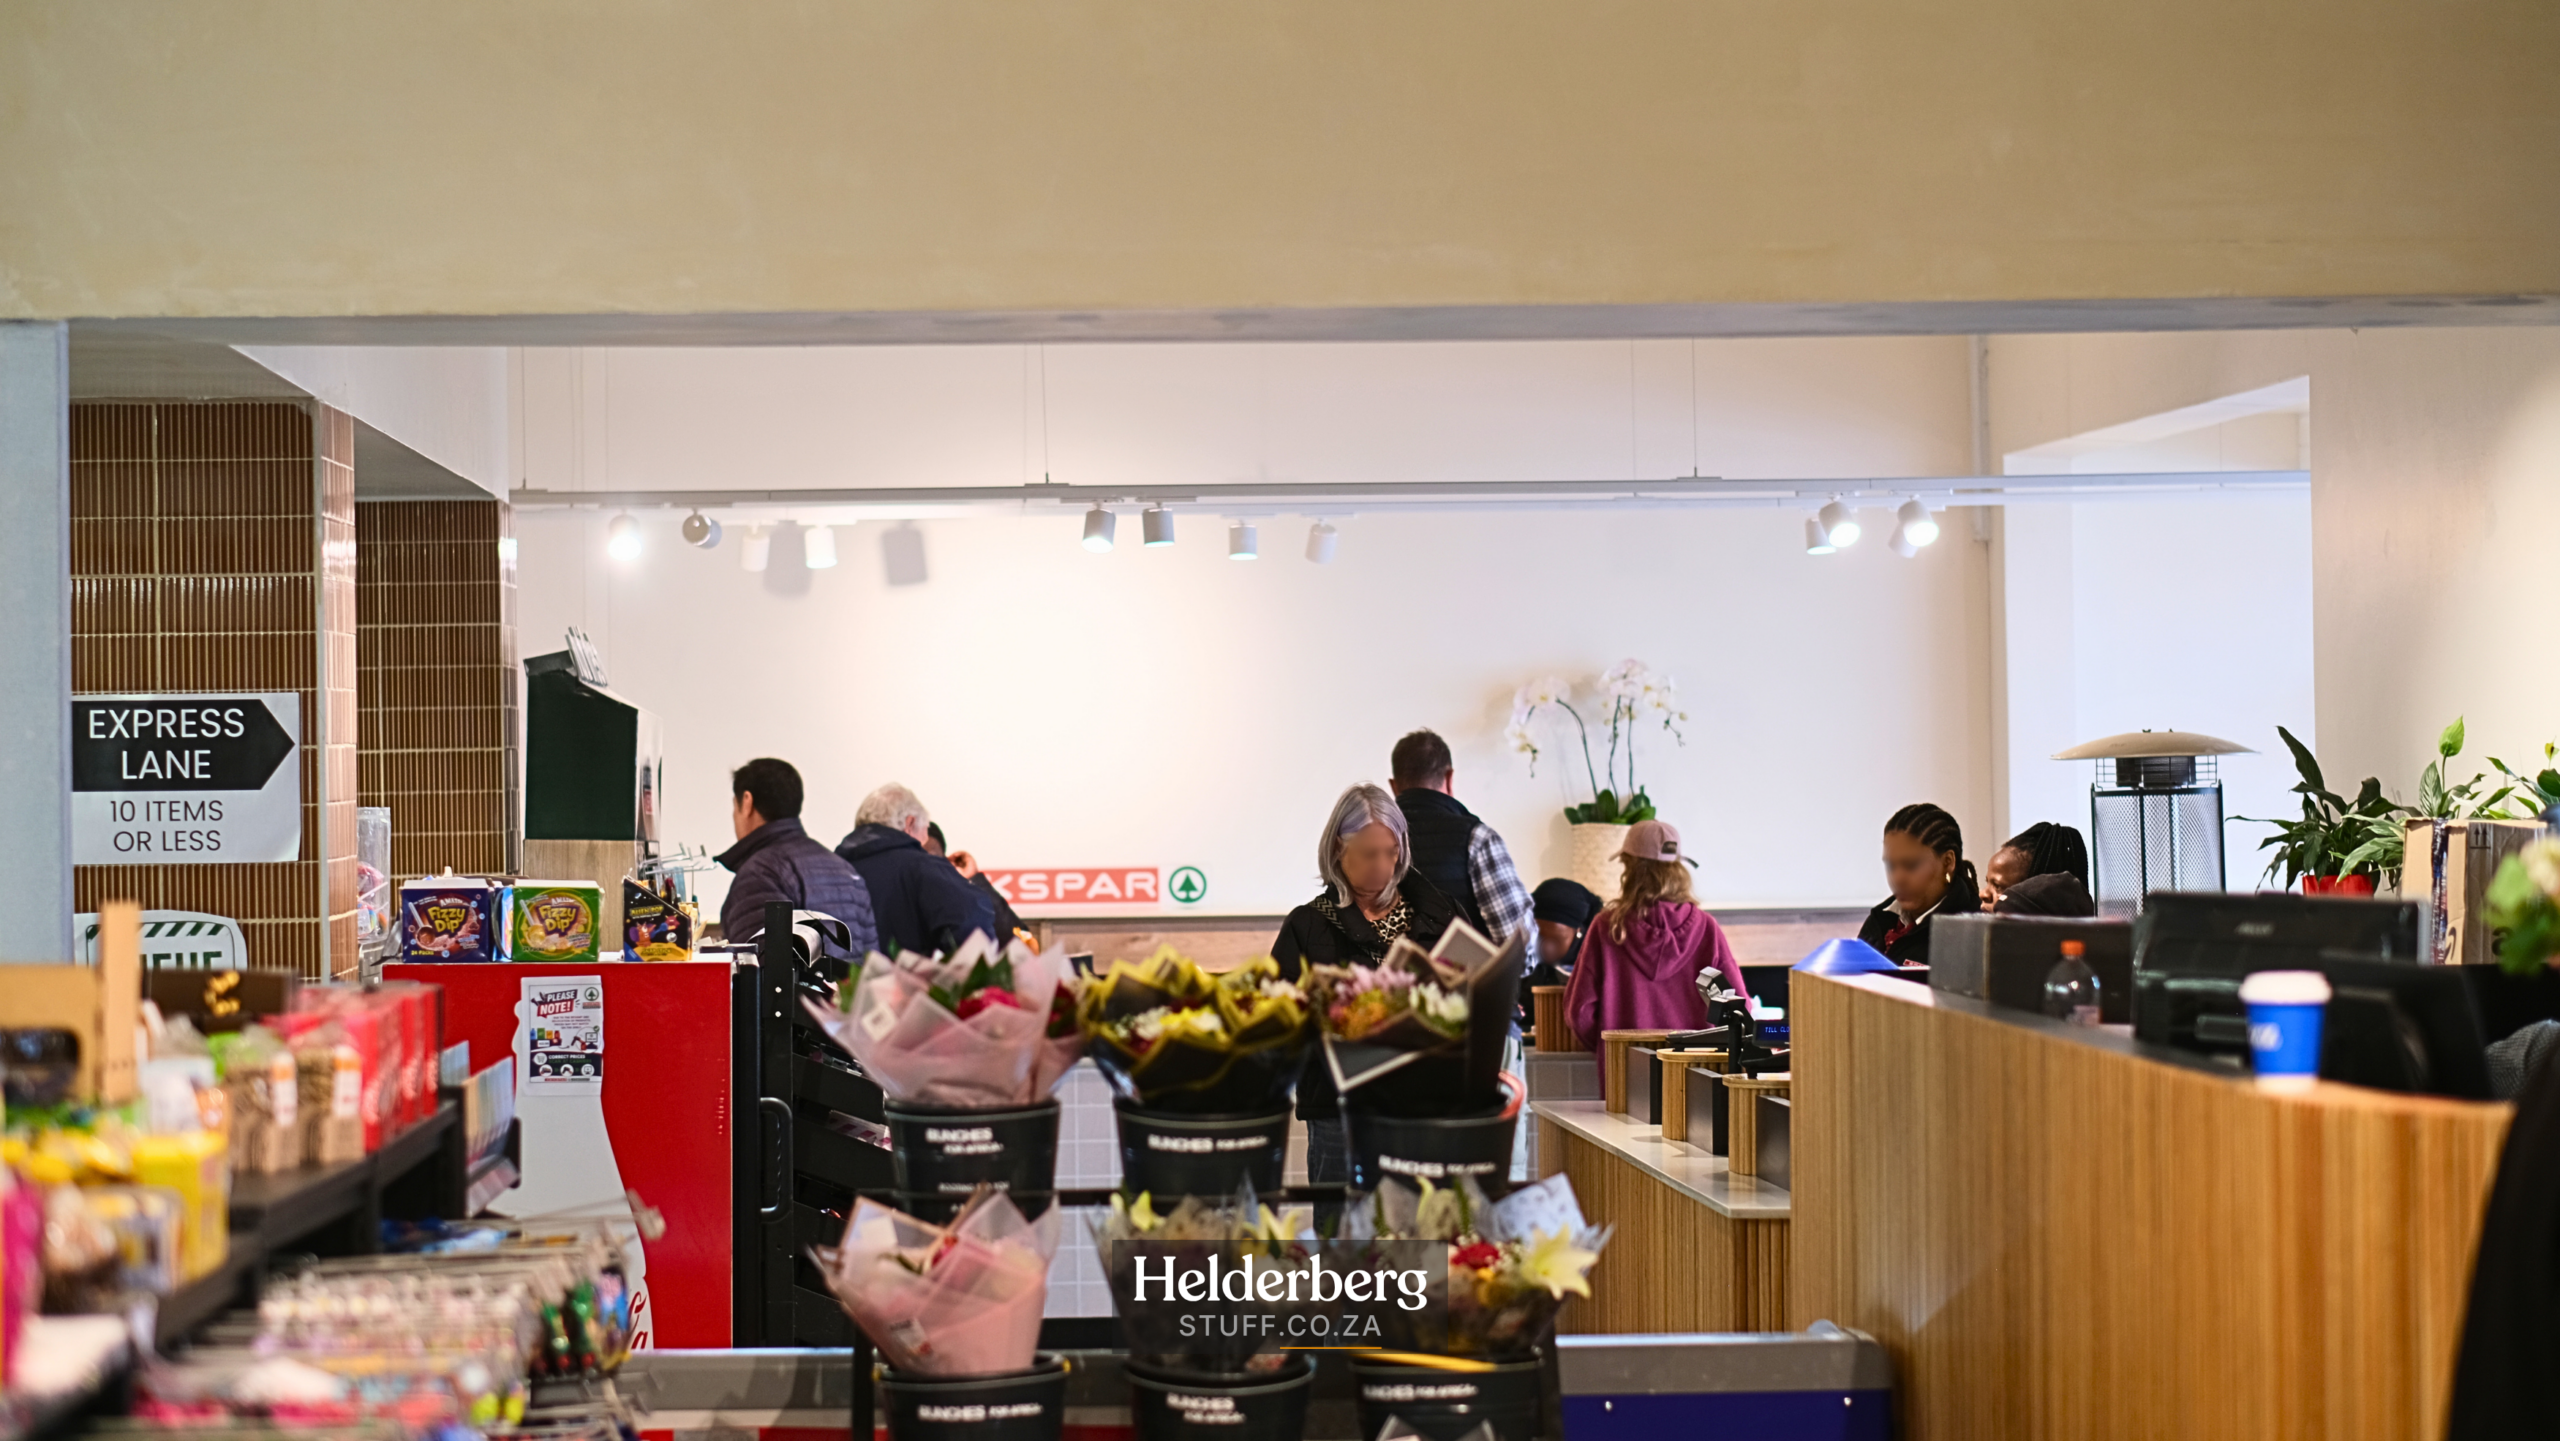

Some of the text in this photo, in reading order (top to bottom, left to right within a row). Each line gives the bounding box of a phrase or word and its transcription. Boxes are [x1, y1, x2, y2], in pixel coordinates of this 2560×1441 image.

[89, 708, 245, 739] EXPRESS
[122, 750, 212, 780] LANE
[110, 800, 223, 822] 10 ITEMS
[113, 830, 221, 852] OR LESS
[547, 990, 576, 1002] PLEASE
[540, 1001, 571, 1015] NOTE!
